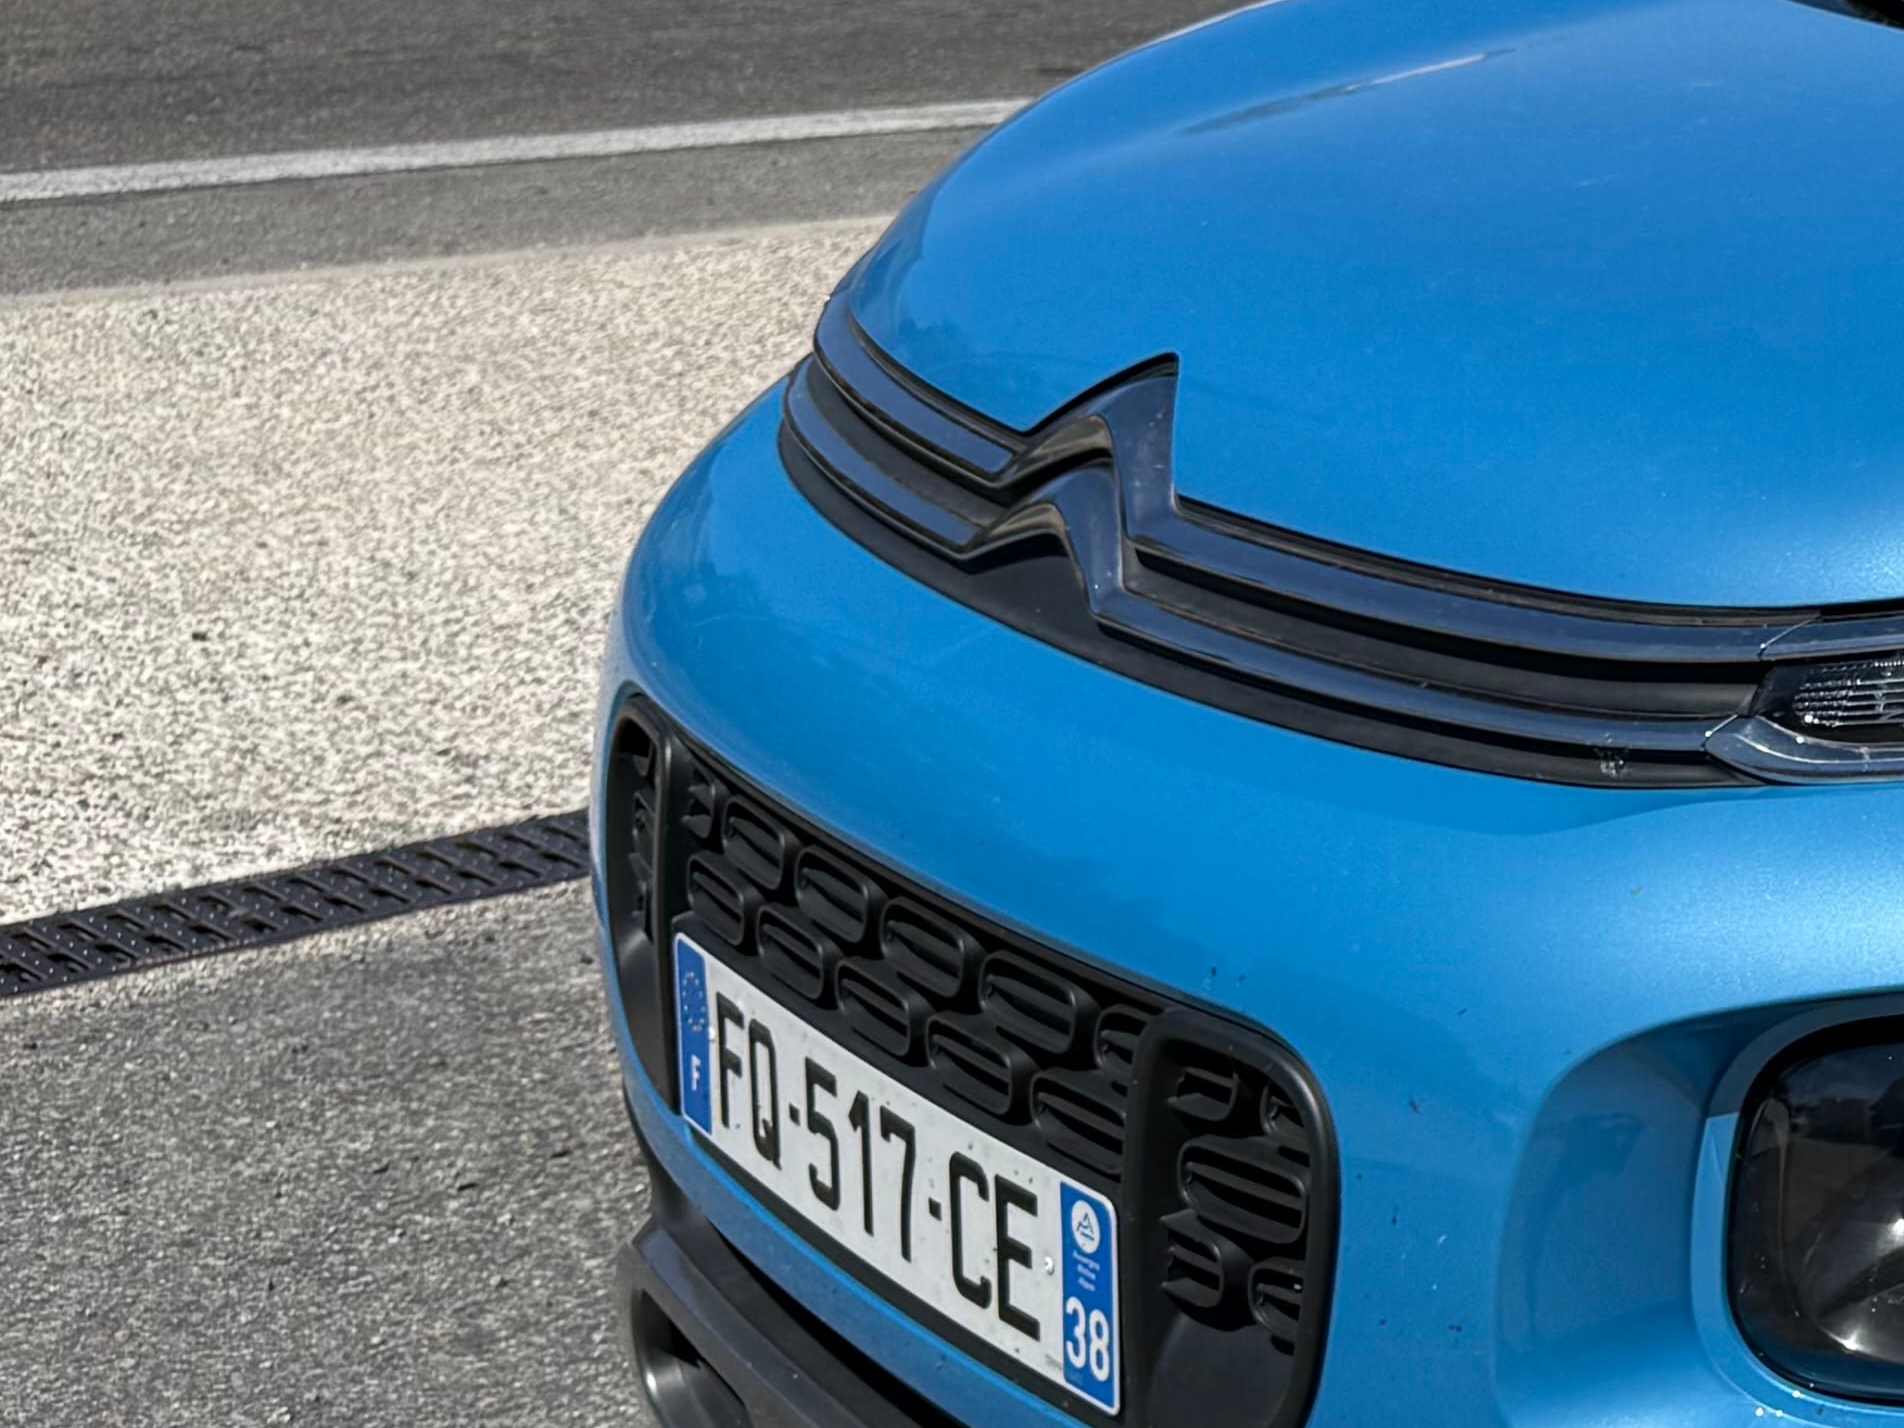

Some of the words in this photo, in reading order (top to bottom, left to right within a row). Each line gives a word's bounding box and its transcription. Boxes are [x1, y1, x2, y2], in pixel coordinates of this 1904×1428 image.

[690, 1054, 702, 1091] F
[715, 991, 1042, 1341] FQ-517-CE
[1065, 1295, 1111, 1383] 38
